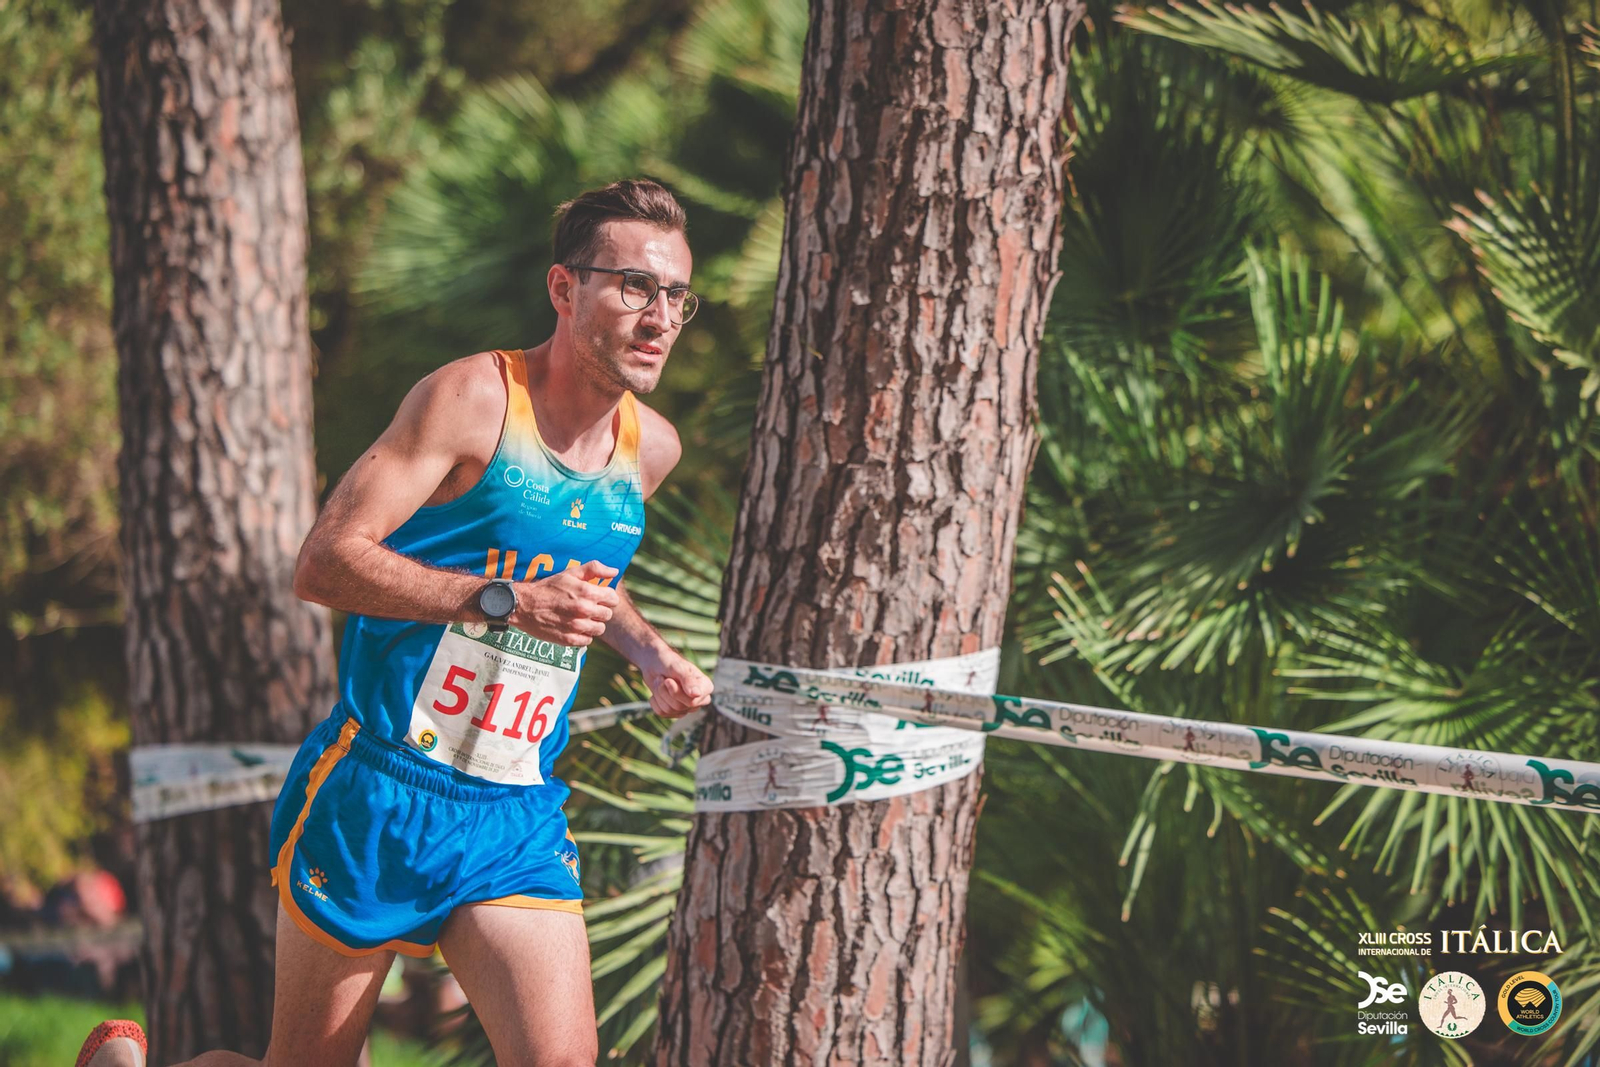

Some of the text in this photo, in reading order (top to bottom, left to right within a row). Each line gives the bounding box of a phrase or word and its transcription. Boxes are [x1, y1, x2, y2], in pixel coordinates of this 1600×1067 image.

[525, 478, 550, 494] Costa
[523, 489, 550, 505] Cálida
[562, 518, 587, 531] KELME
[432, 665, 555, 743] 5116
[1329, 745, 1414, 771] Diputación
[296, 880, 328, 902] KELME
